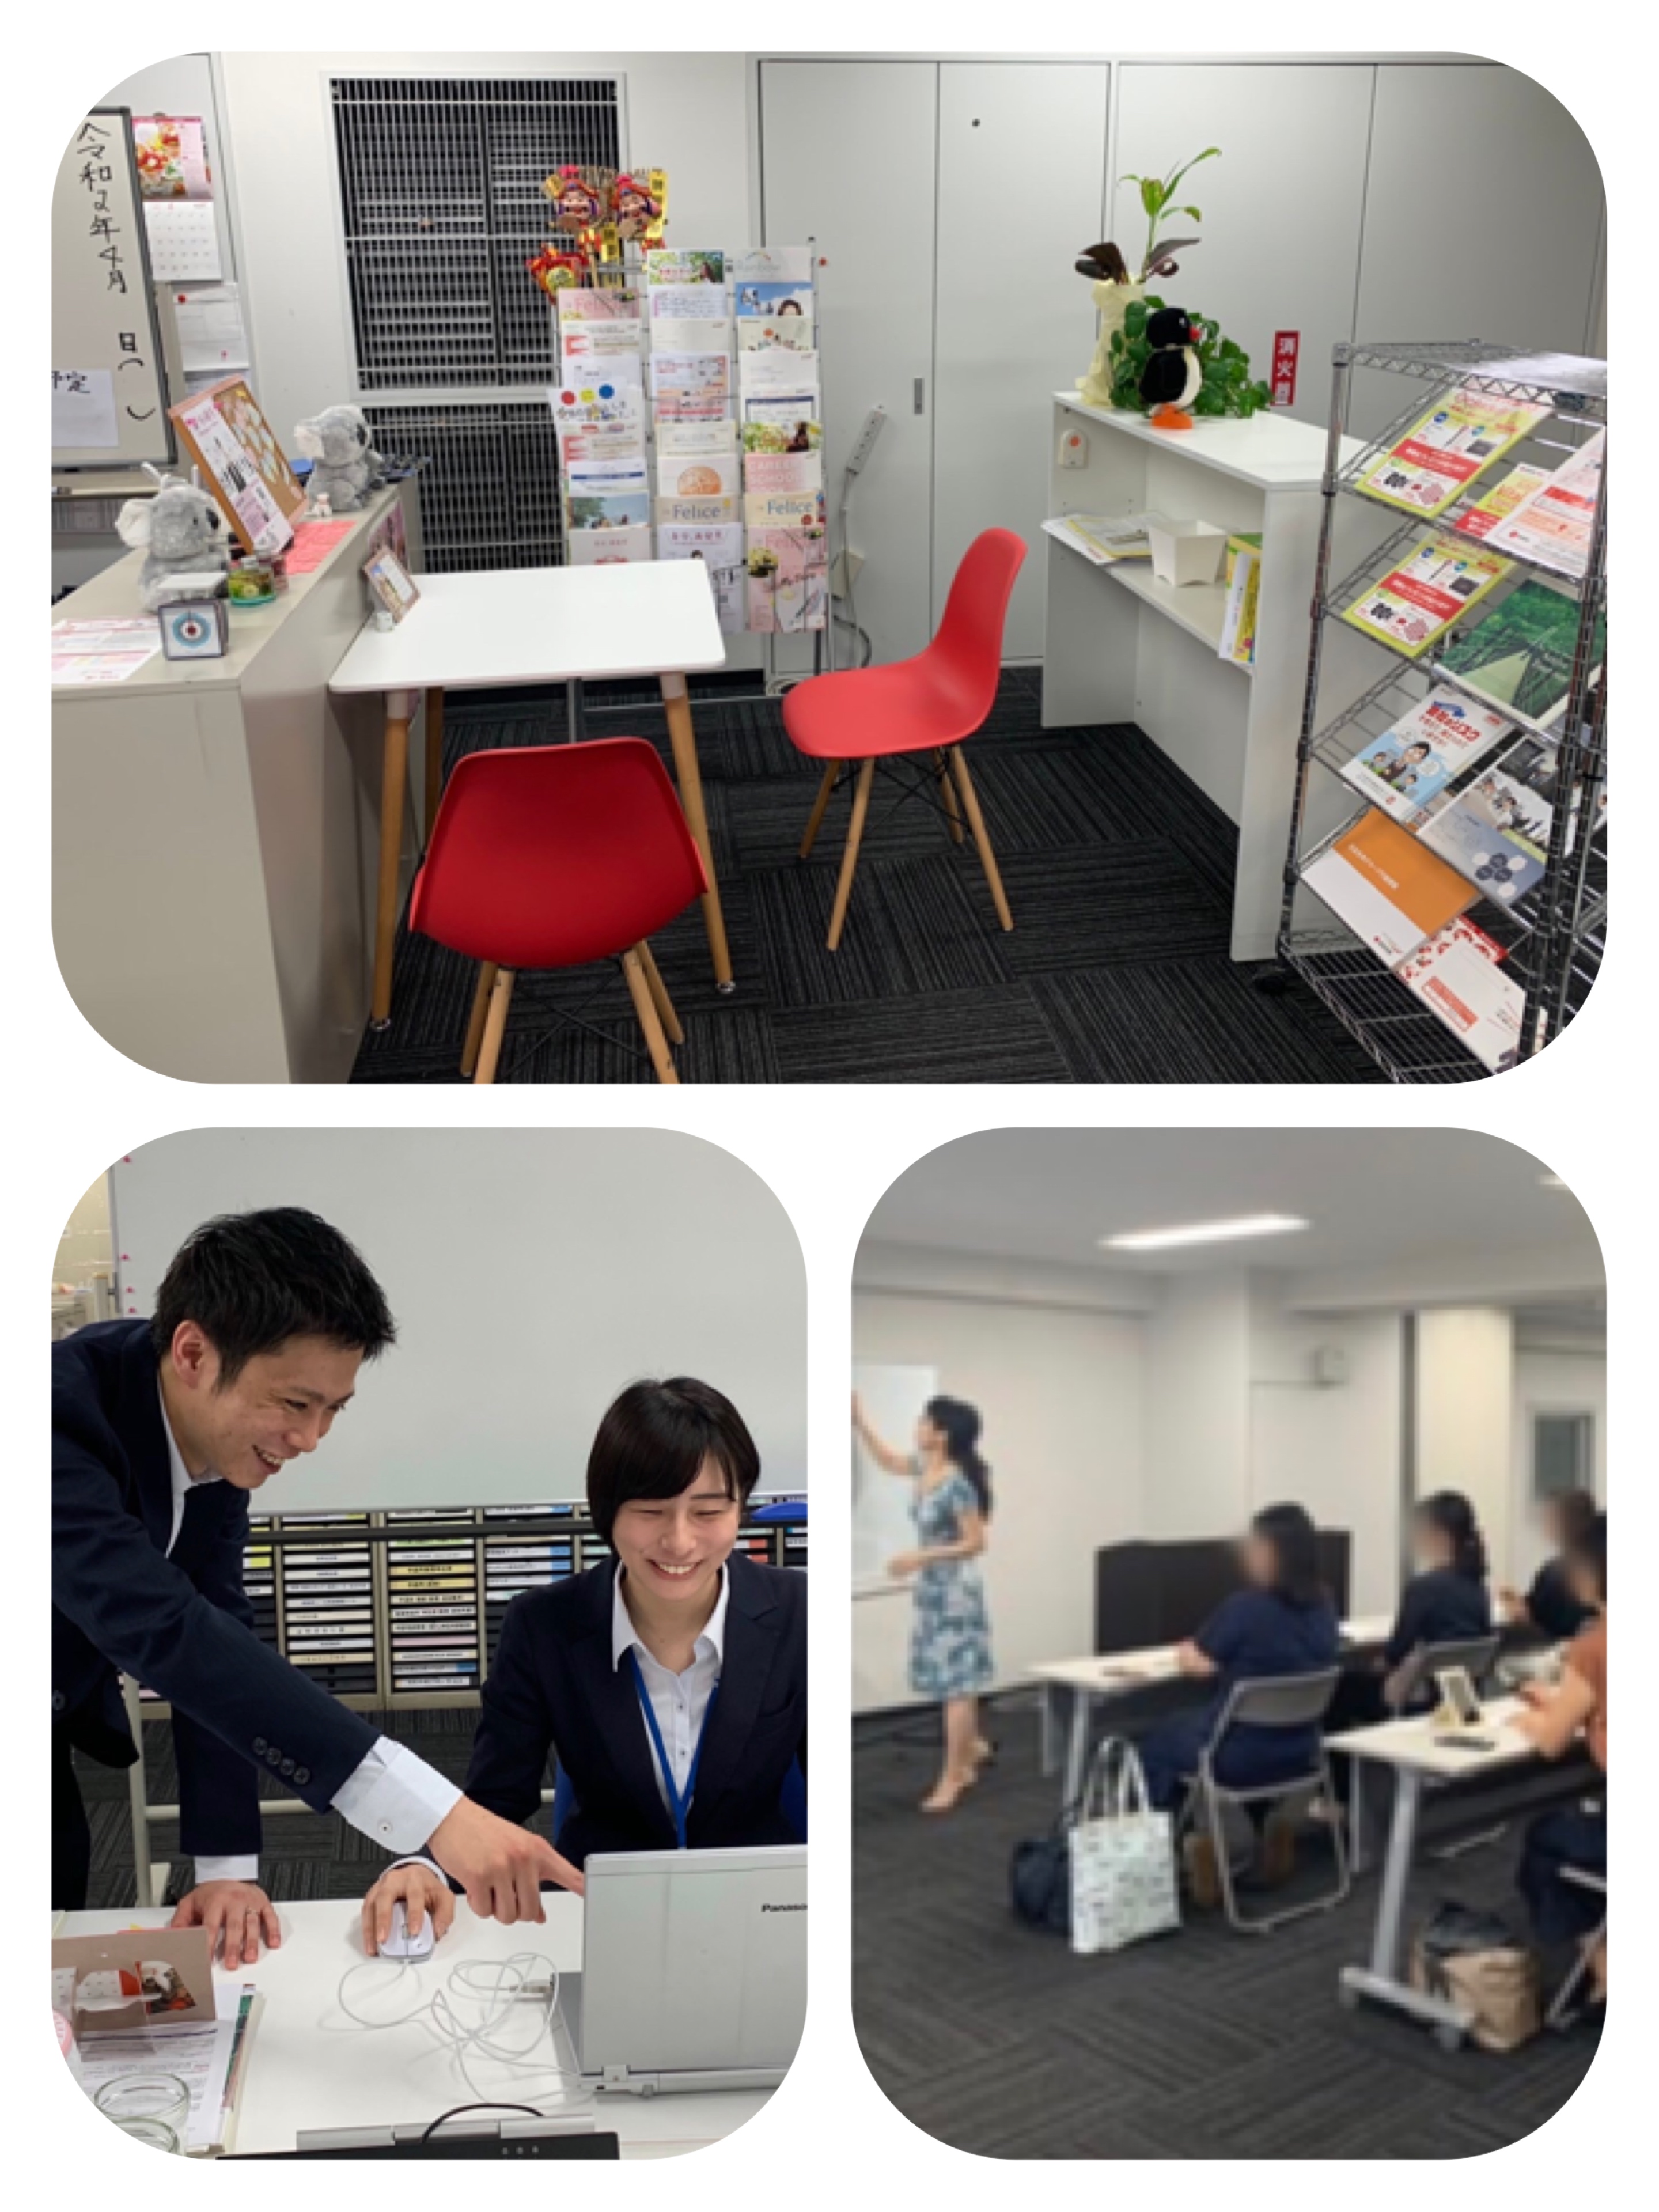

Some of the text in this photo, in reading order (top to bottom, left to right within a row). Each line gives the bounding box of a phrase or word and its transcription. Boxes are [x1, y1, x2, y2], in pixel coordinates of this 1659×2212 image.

[77, 122, 126, 293] 令和2年4月
[673, 503, 721, 520] Felice
[767, 498, 812, 516] Felice
